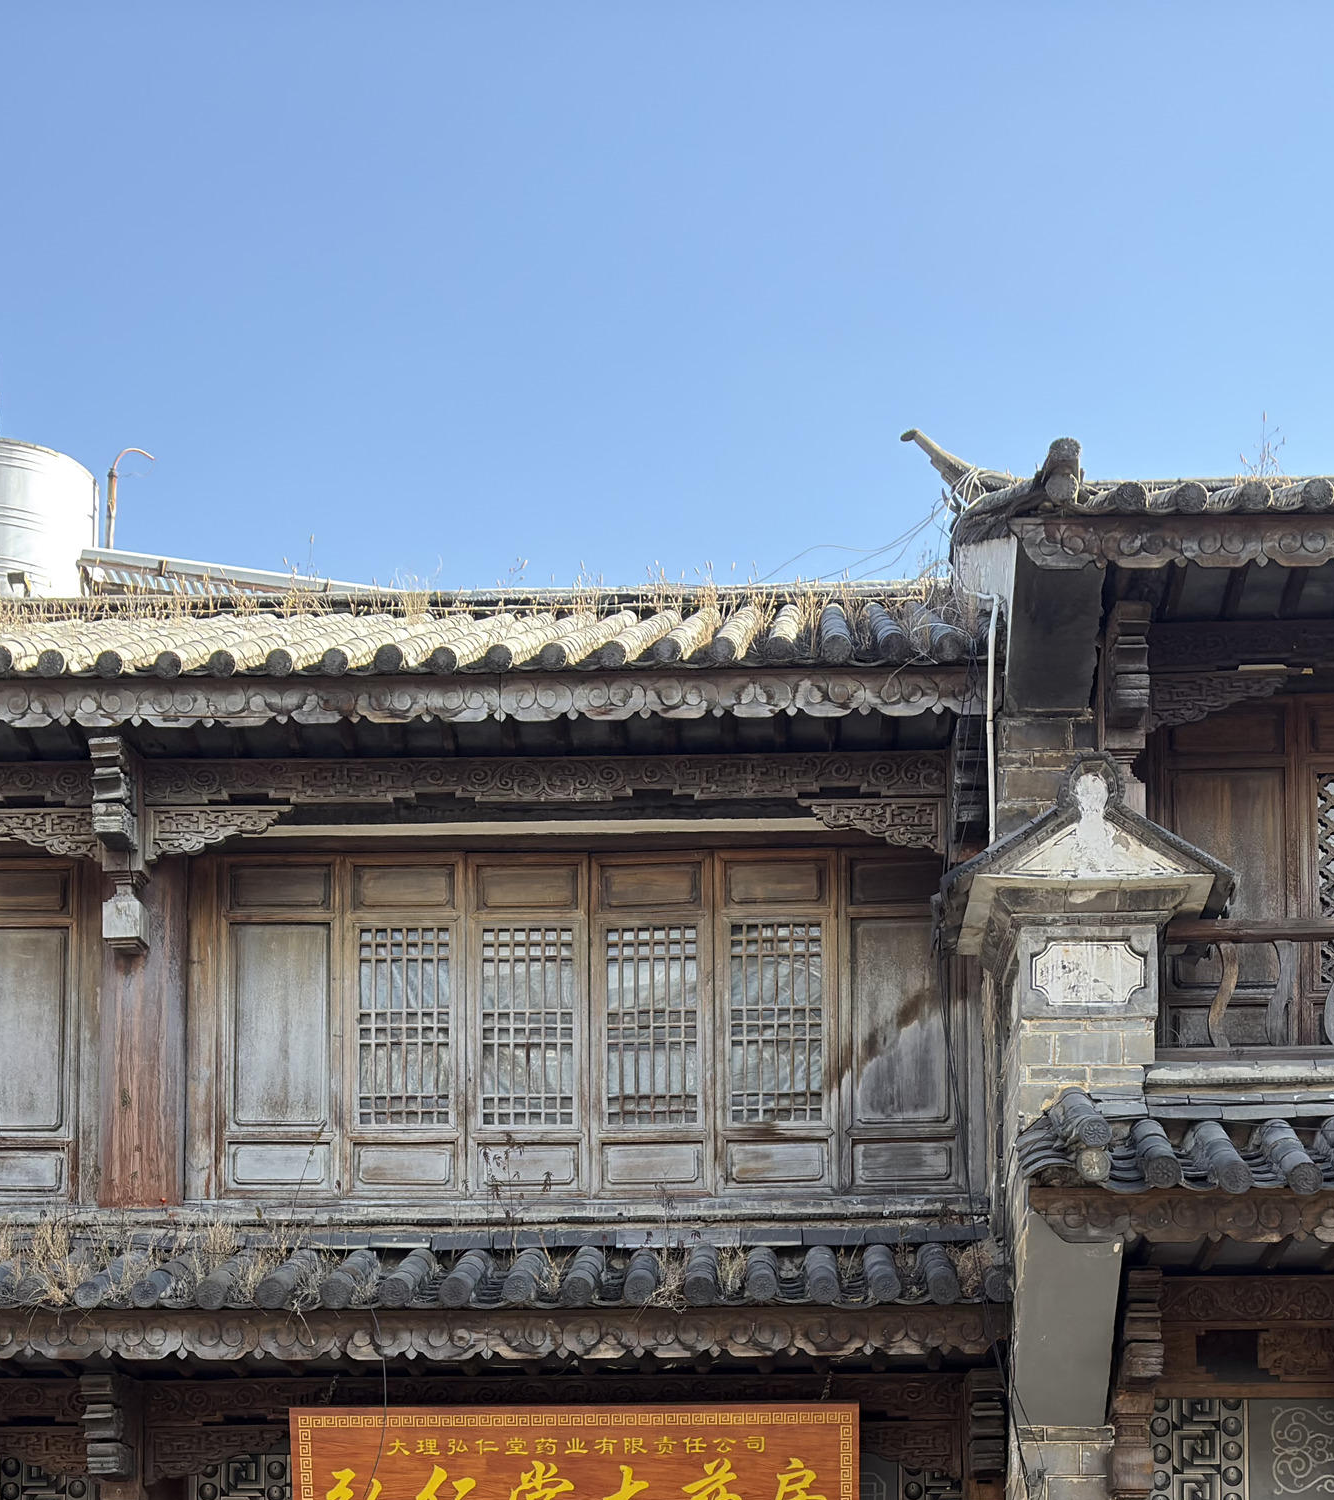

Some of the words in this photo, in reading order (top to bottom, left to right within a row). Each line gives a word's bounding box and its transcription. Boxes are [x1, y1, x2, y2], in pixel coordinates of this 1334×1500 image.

[386, 1435, 768, 1456] 大理弘仁堂药业有限责任公司
